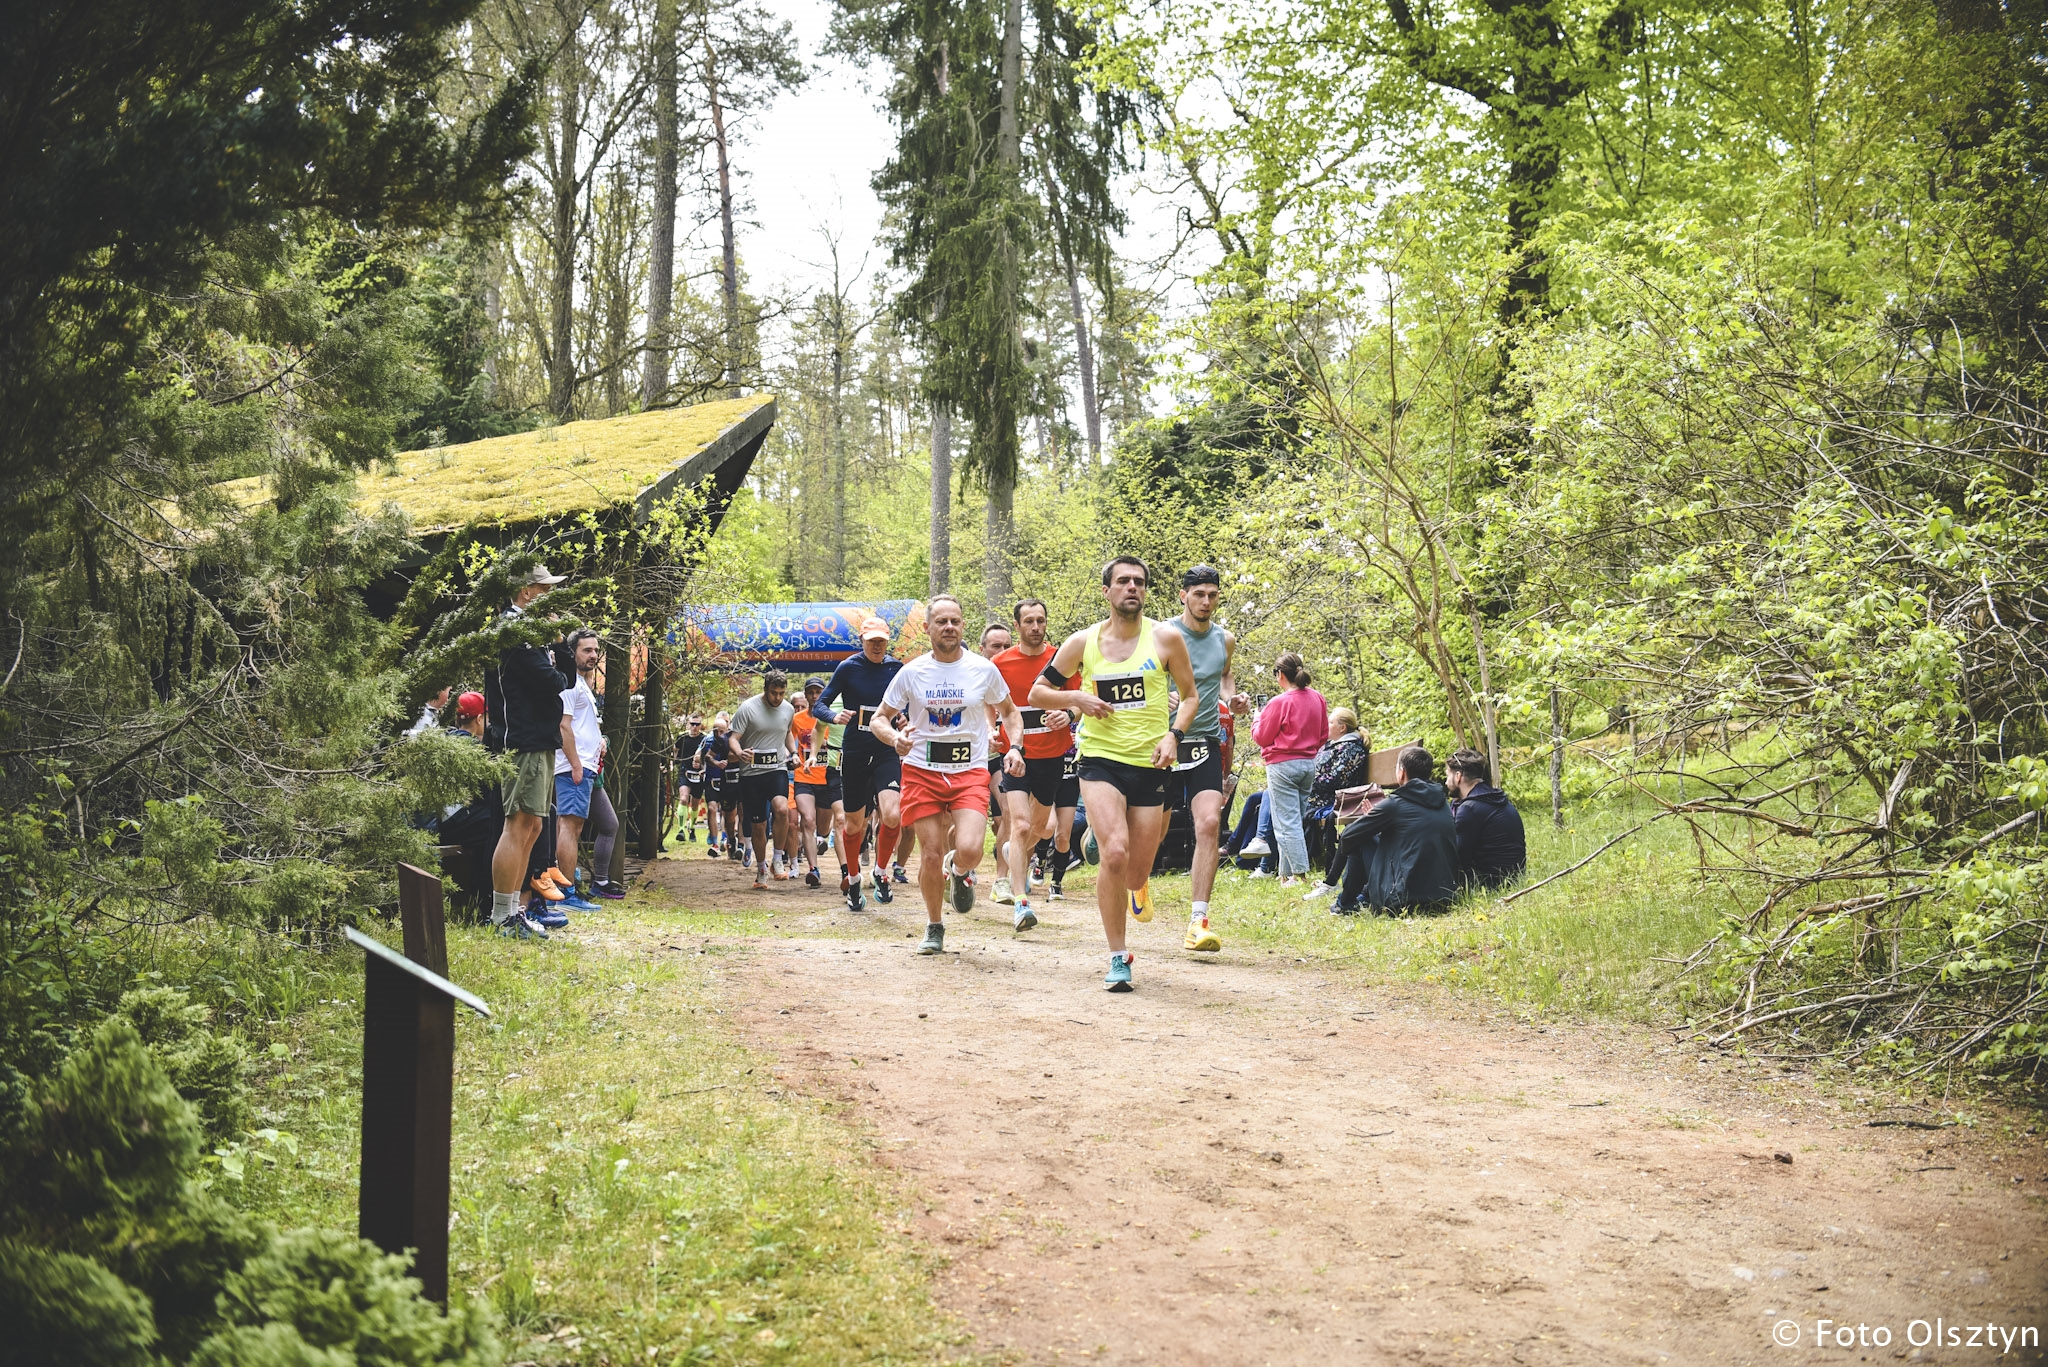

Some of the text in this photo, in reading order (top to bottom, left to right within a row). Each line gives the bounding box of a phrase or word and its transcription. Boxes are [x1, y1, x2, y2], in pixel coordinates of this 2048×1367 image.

[763, 615, 838, 633] YO&GO
[773, 635, 826, 648] EVENTS
[925, 689, 965, 699] MŁAWSKIE
[1111, 682, 1144, 700] 126
[761, 754, 777, 764] 134
[951, 746, 970, 761] 52
[1191, 746, 1208, 760] 65
